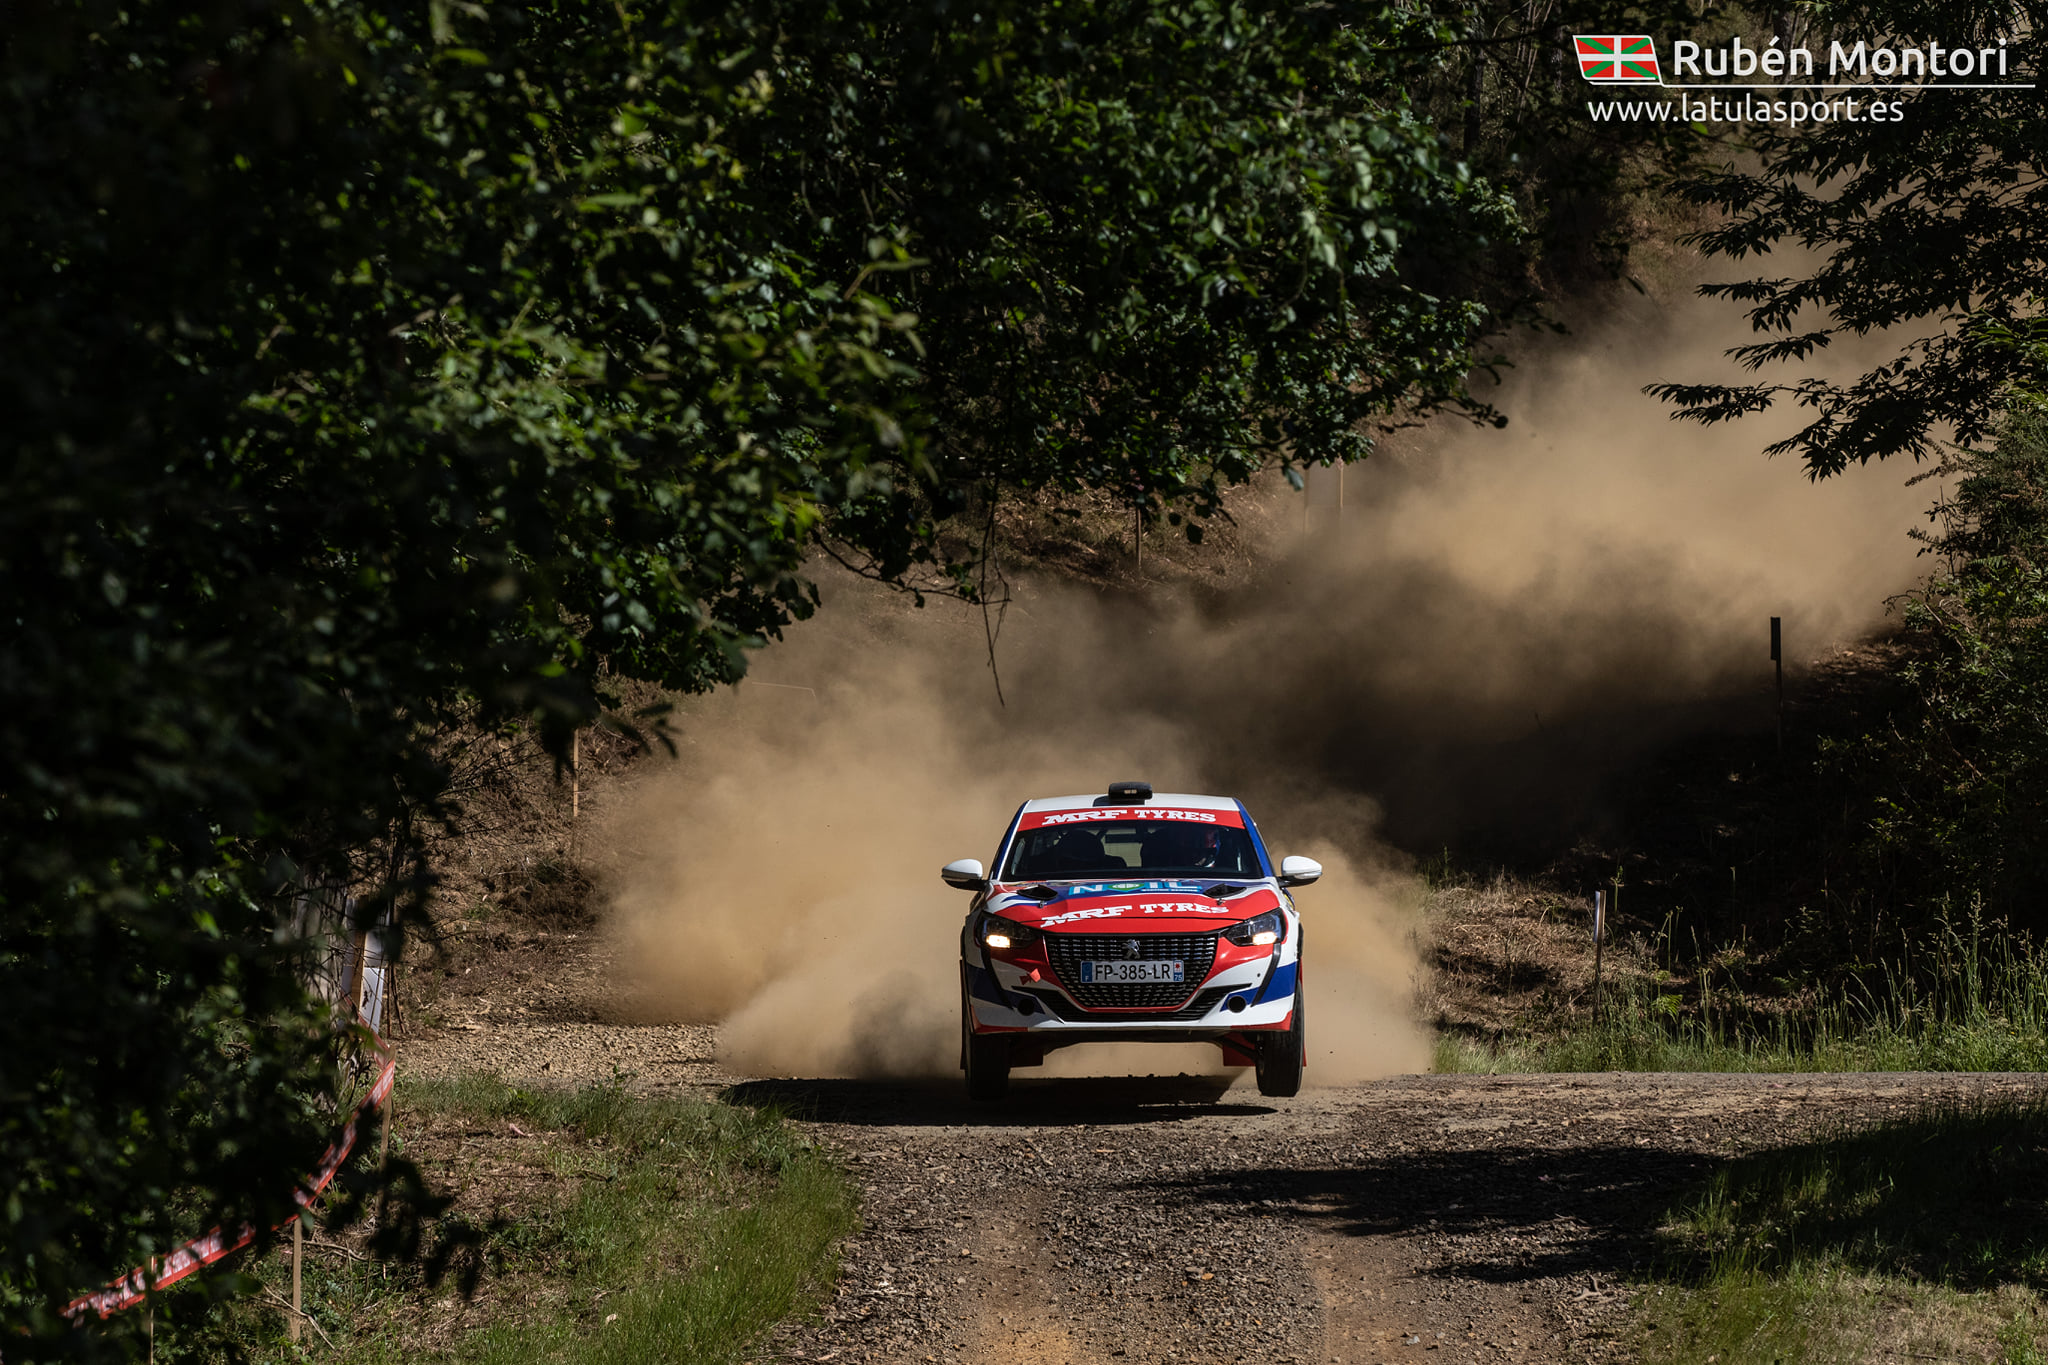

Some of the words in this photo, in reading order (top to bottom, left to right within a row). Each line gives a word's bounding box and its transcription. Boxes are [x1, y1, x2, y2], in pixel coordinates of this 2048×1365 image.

[1042, 809, 1128, 826] MRF
[1134, 809, 1217, 822] TYRES
[1040, 904, 1132, 928] MRF
[1139, 903, 1230, 914] TYRES
[1095, 964, 1171, 981] FP-385-LR
